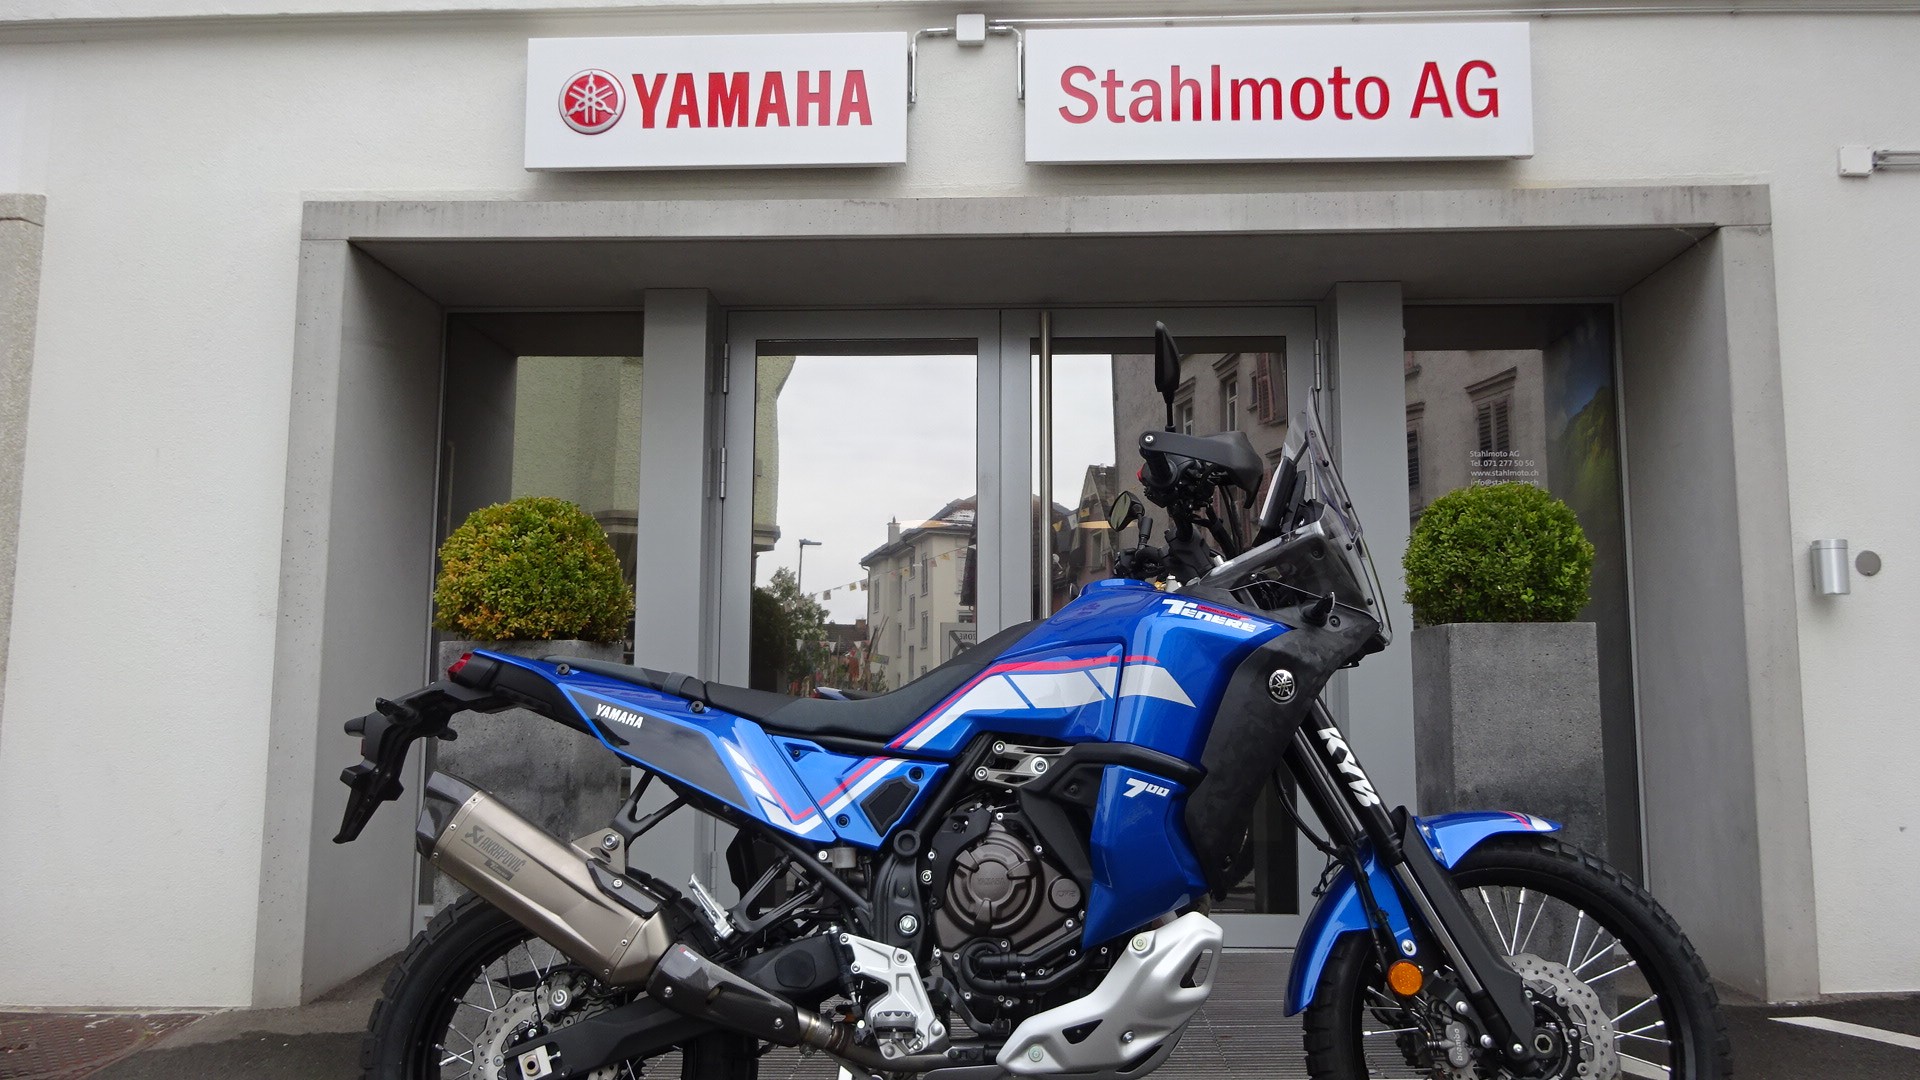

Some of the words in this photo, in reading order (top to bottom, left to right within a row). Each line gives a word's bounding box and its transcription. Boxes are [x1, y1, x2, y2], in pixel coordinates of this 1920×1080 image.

[632, 70, 873, 129] YAMAHA
[1058, 64, 1390, 124] Stahlmoto
[1410, 60, 1500, 119] AG
[1469, 450, 1508, 458] Stahlmoto
[1470, 469, 1539, 477] www.stahlmoto.ch
[595, 703, 644, 729] YAMAHA
[1317, 727, 1380, 807] KYB
[1123, 777, 1170, 798] 700
[1453, 1028, 1463, 1061] brembo
